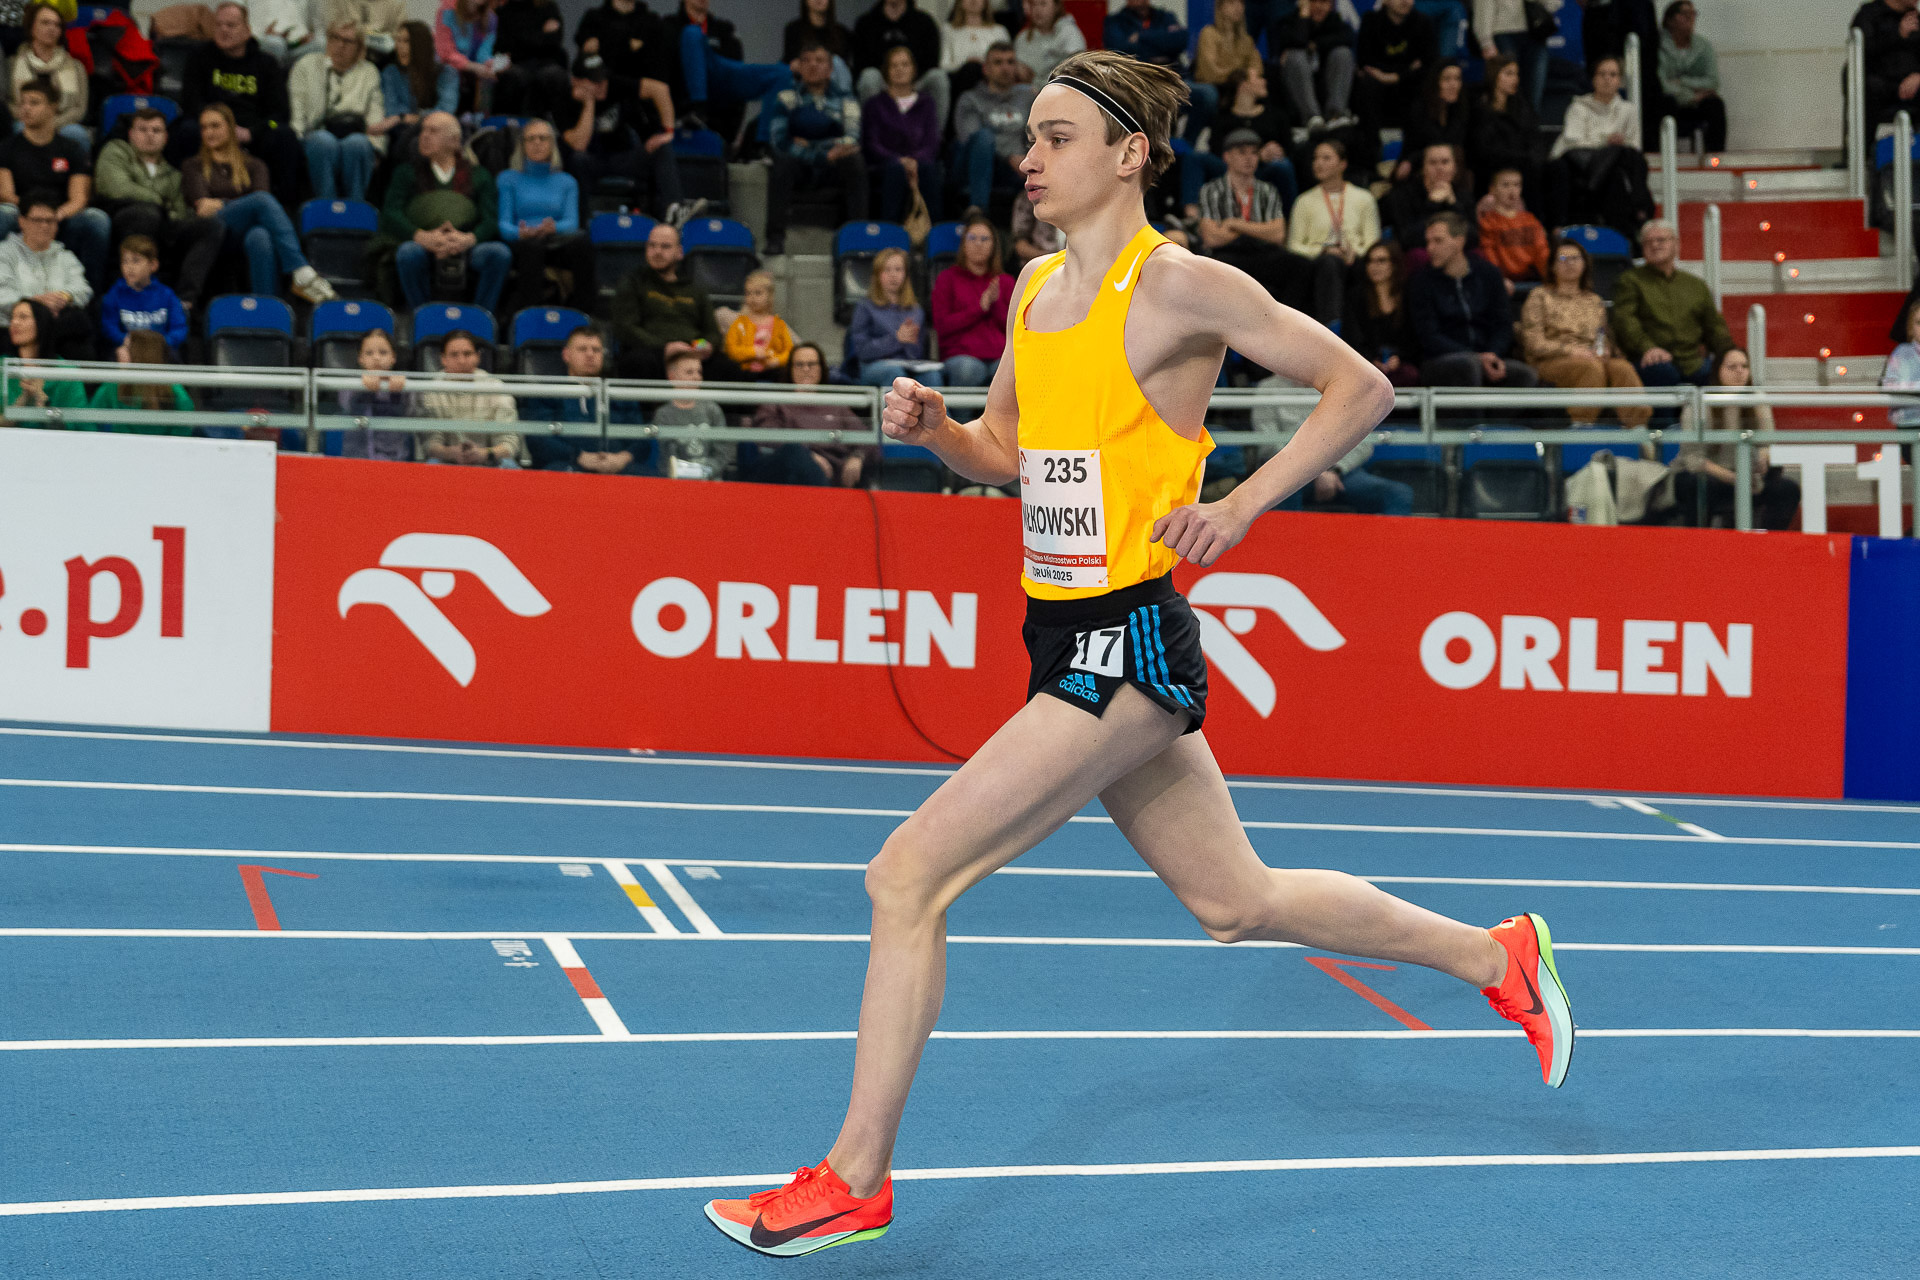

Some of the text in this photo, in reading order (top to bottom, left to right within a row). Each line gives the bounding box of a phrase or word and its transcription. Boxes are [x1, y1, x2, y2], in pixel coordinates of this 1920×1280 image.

[1043, 457, 1088, 483] 235
[1052, 569, 1073, 582] 2025
[1078, 556, 1102, 565] Polski
[0, 524, 187, 669] .pl
[630, 576, 978, 669] ORLEN
[1078, 630, 1122, 667] 17
[1419, 611, 1753, 698] ORLEN
[1059, 678, 1101, 703] adidas
